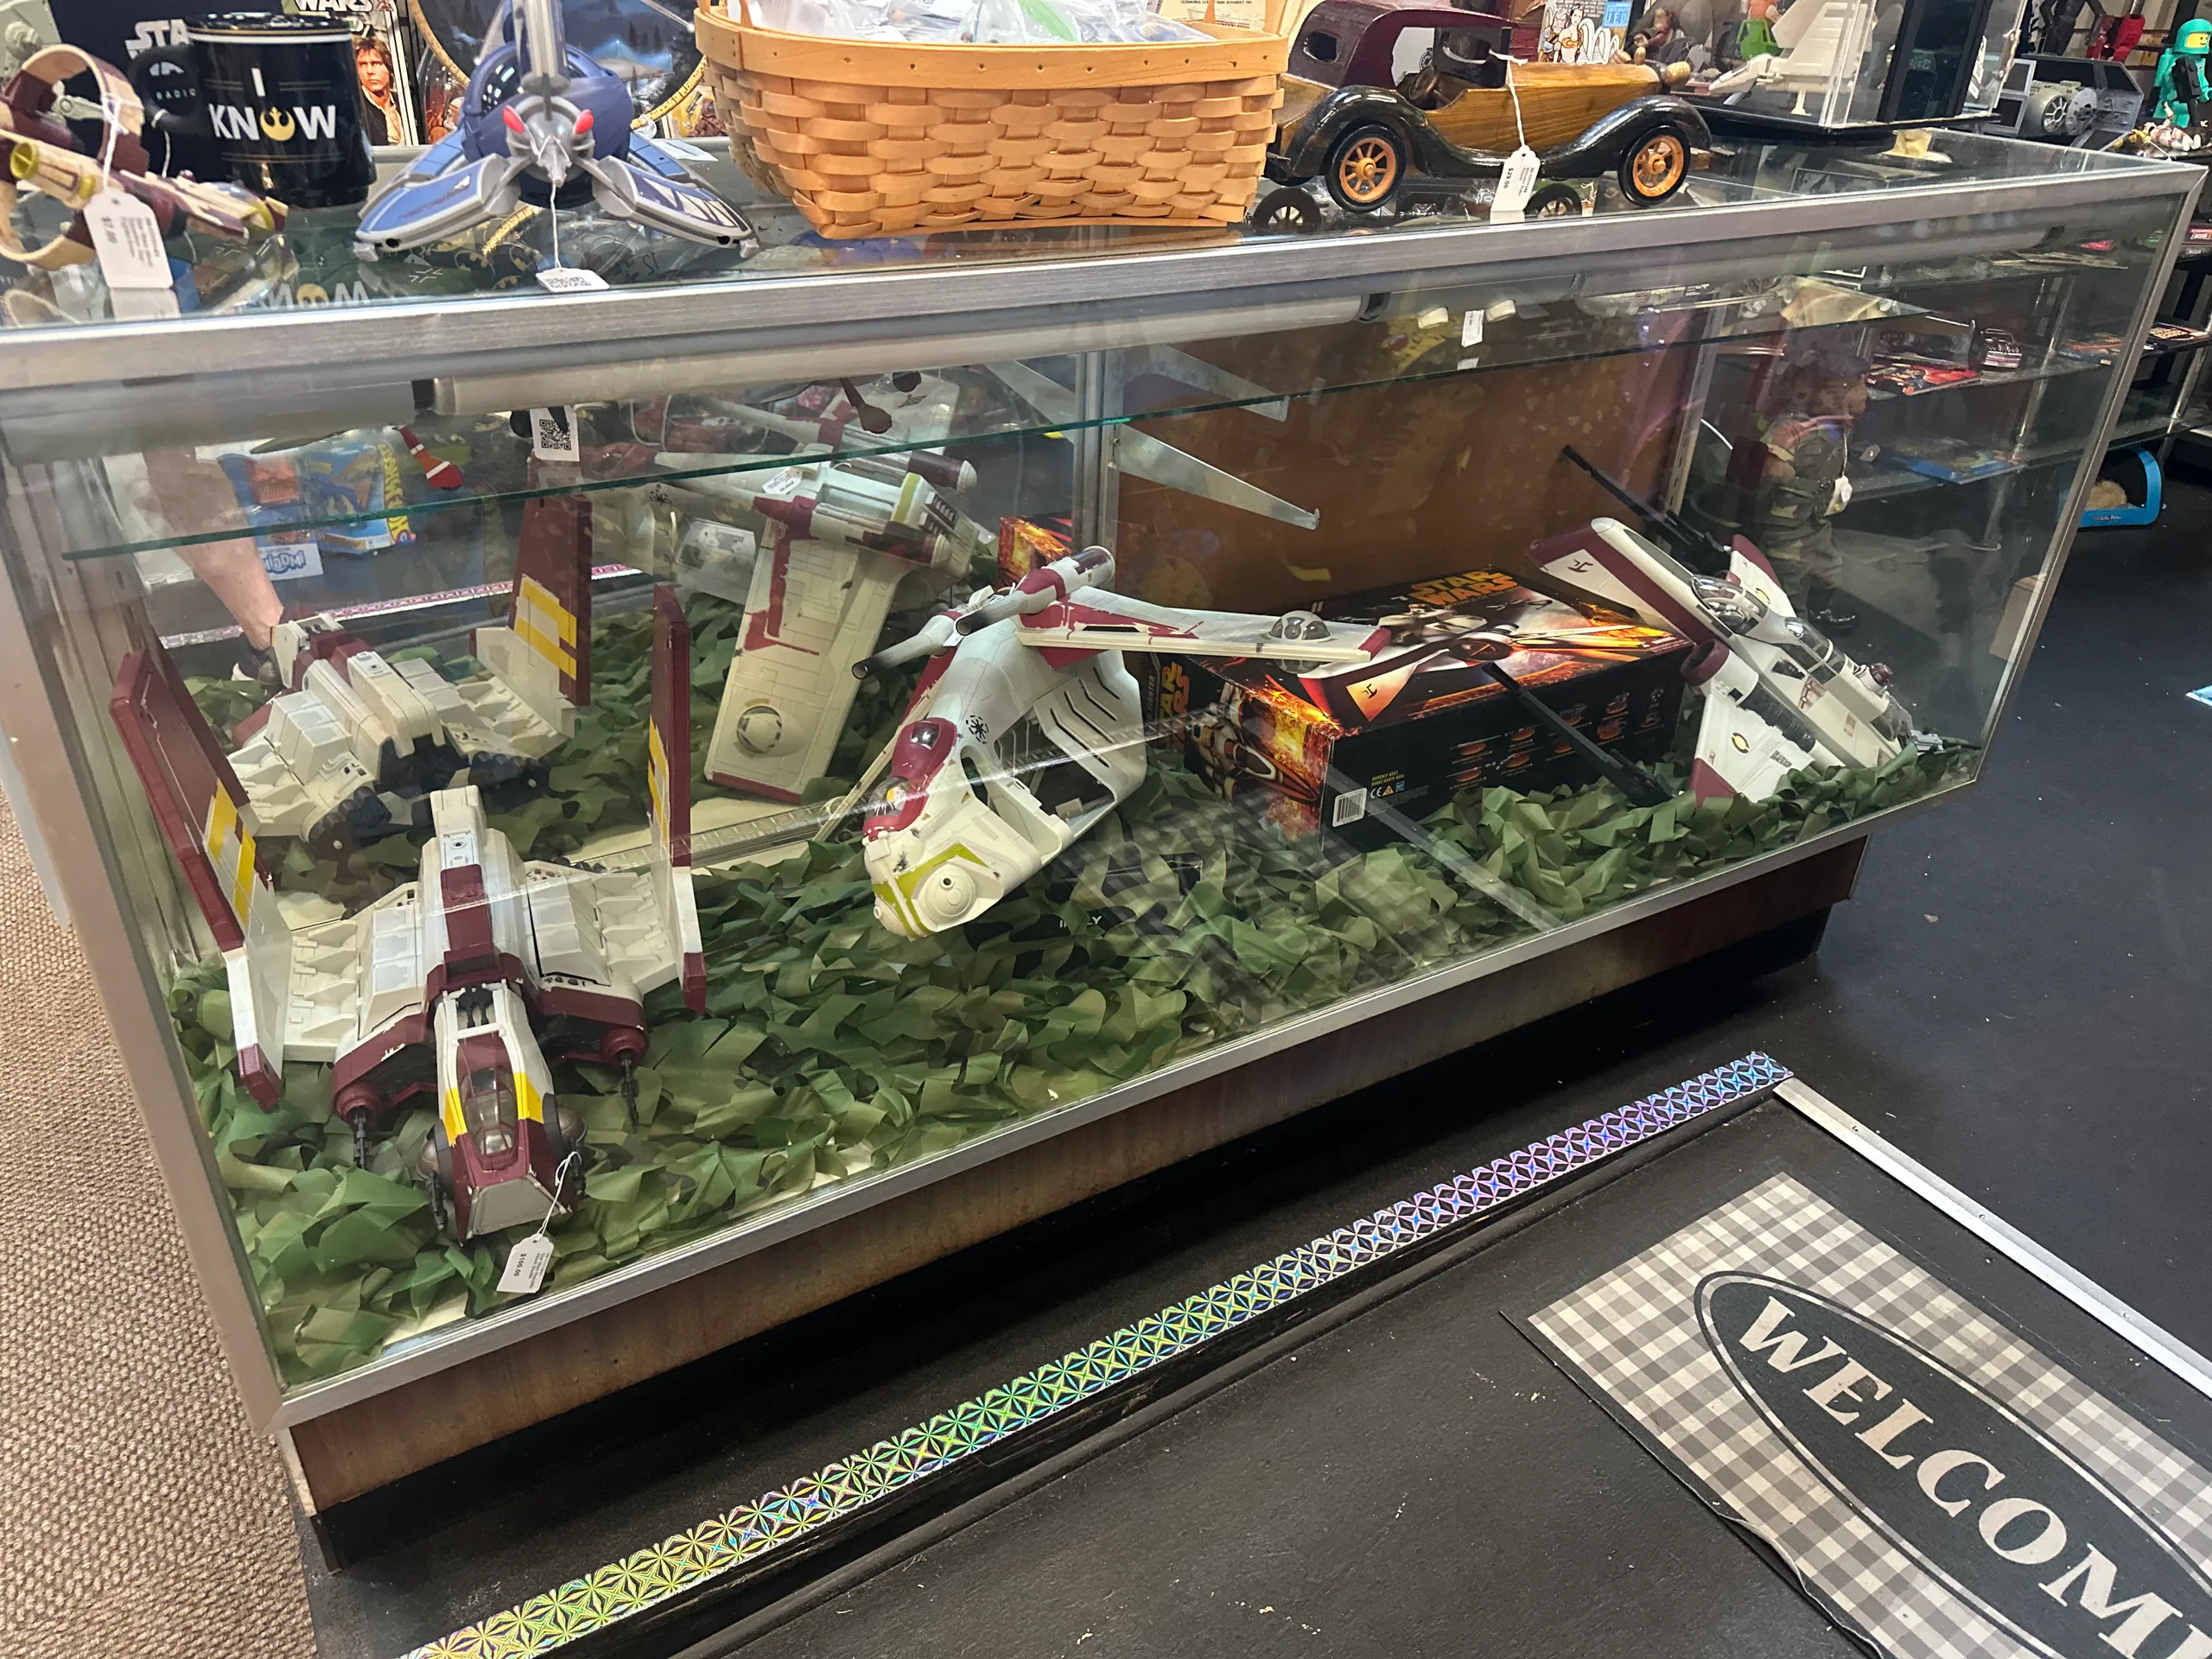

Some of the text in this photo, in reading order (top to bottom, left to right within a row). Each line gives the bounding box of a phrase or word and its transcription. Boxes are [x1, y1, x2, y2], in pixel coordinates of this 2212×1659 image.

[124, 18, 189, 49] STA
[156, 87, 197, 100] RADIO
[251, 67, 266, 97] I
[1503, 167, 1514, 188] $29.00
[1408, 575, 1518, 606] WARS
[1409, 570, 1505, 595] STAR
[513, 1253, 527, 1277] $100.00
[1738, 1296, 2212, 1659] WELCOM
